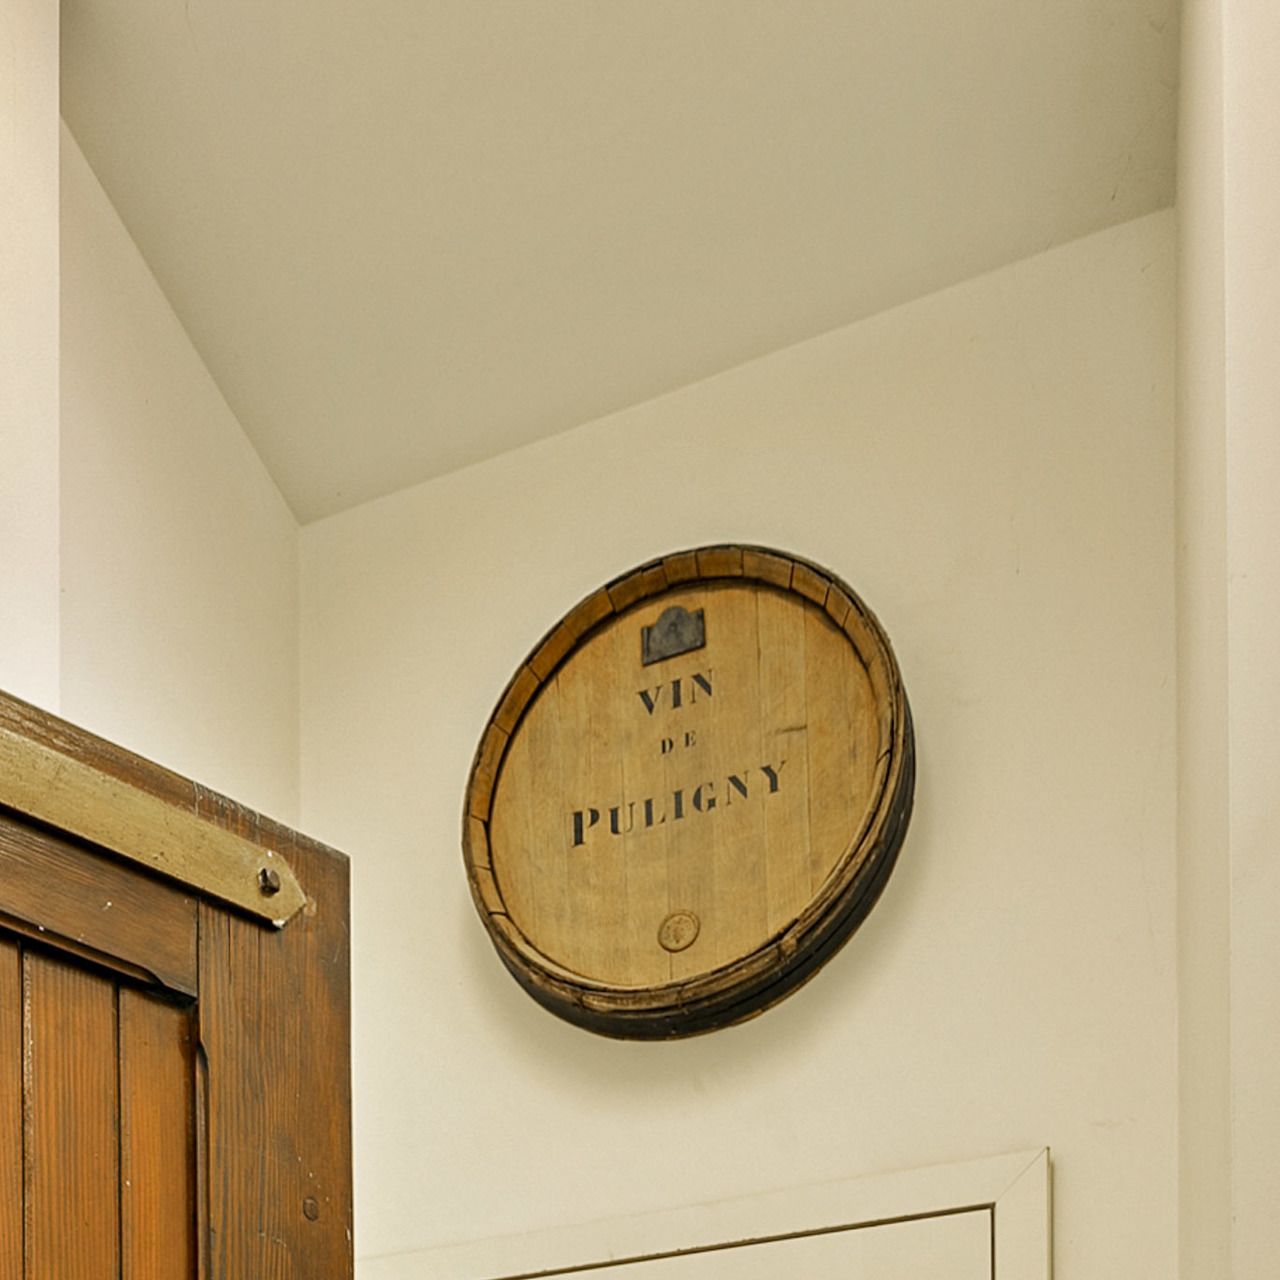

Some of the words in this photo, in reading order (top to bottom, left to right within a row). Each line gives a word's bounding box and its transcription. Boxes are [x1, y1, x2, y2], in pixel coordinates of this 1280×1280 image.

[636, 669, 715, 716] VIN
[660, 730, 697, 755] DE
[571, 760, 787, 848] PULIGNY
